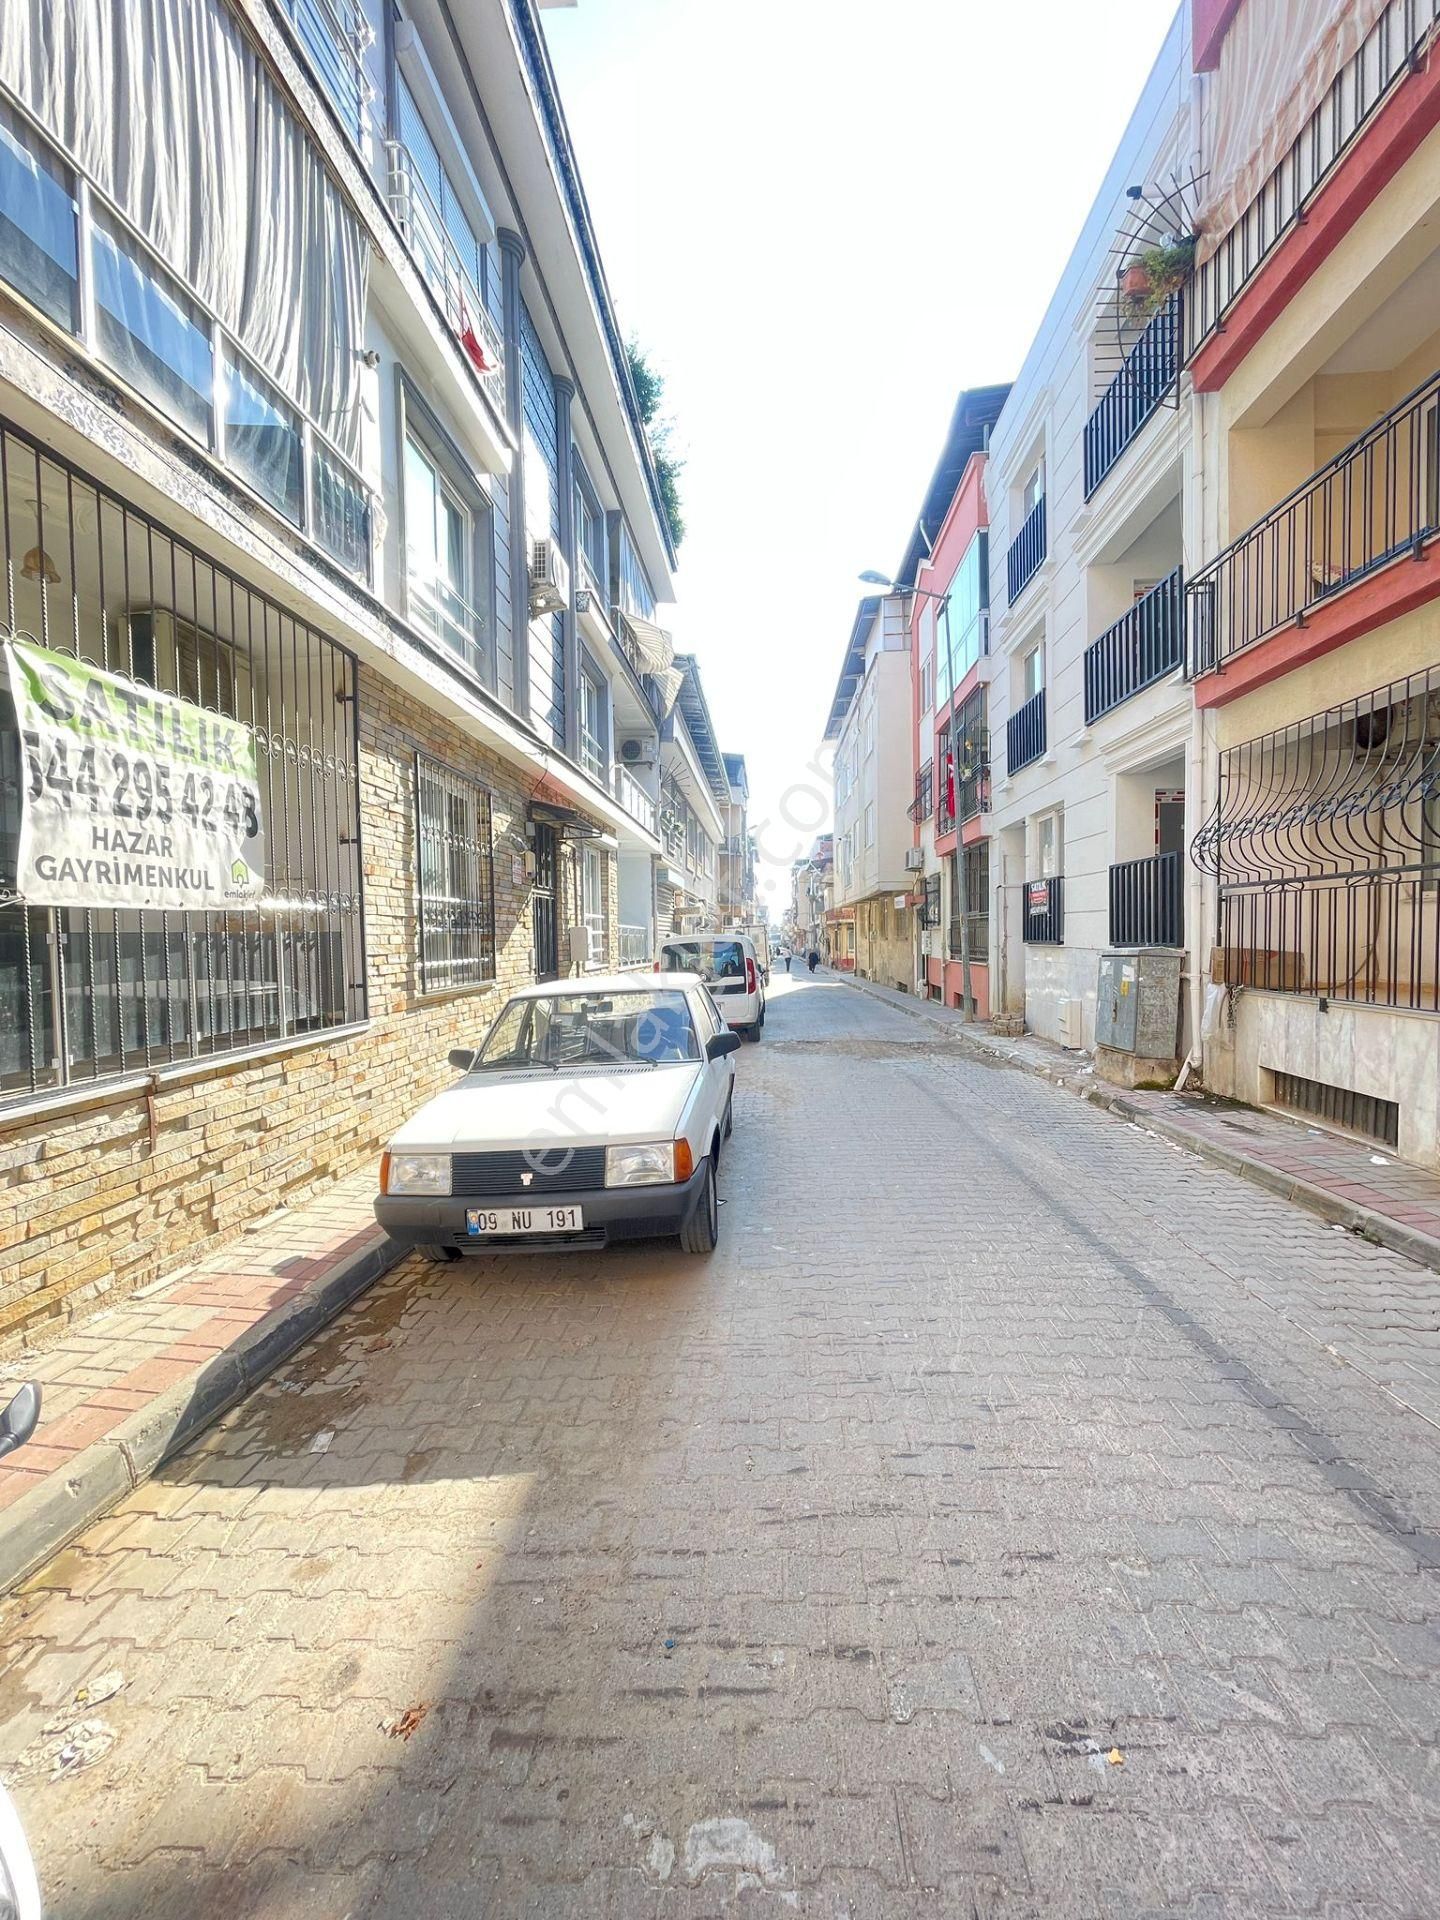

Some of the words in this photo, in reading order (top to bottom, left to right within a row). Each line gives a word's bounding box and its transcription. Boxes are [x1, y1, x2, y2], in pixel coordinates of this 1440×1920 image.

[112, 753, 173, 825] 295
[181, 772, 217, 832] 42
[92, 826, 173, 858] HAZAR
[34, 855, 215, 891] GAYRİMENKUL
[478, 1212, 498, 1231] 09
[512, 1211, 532, 1230] NU
[546, 1209, 577, 1229] 191
